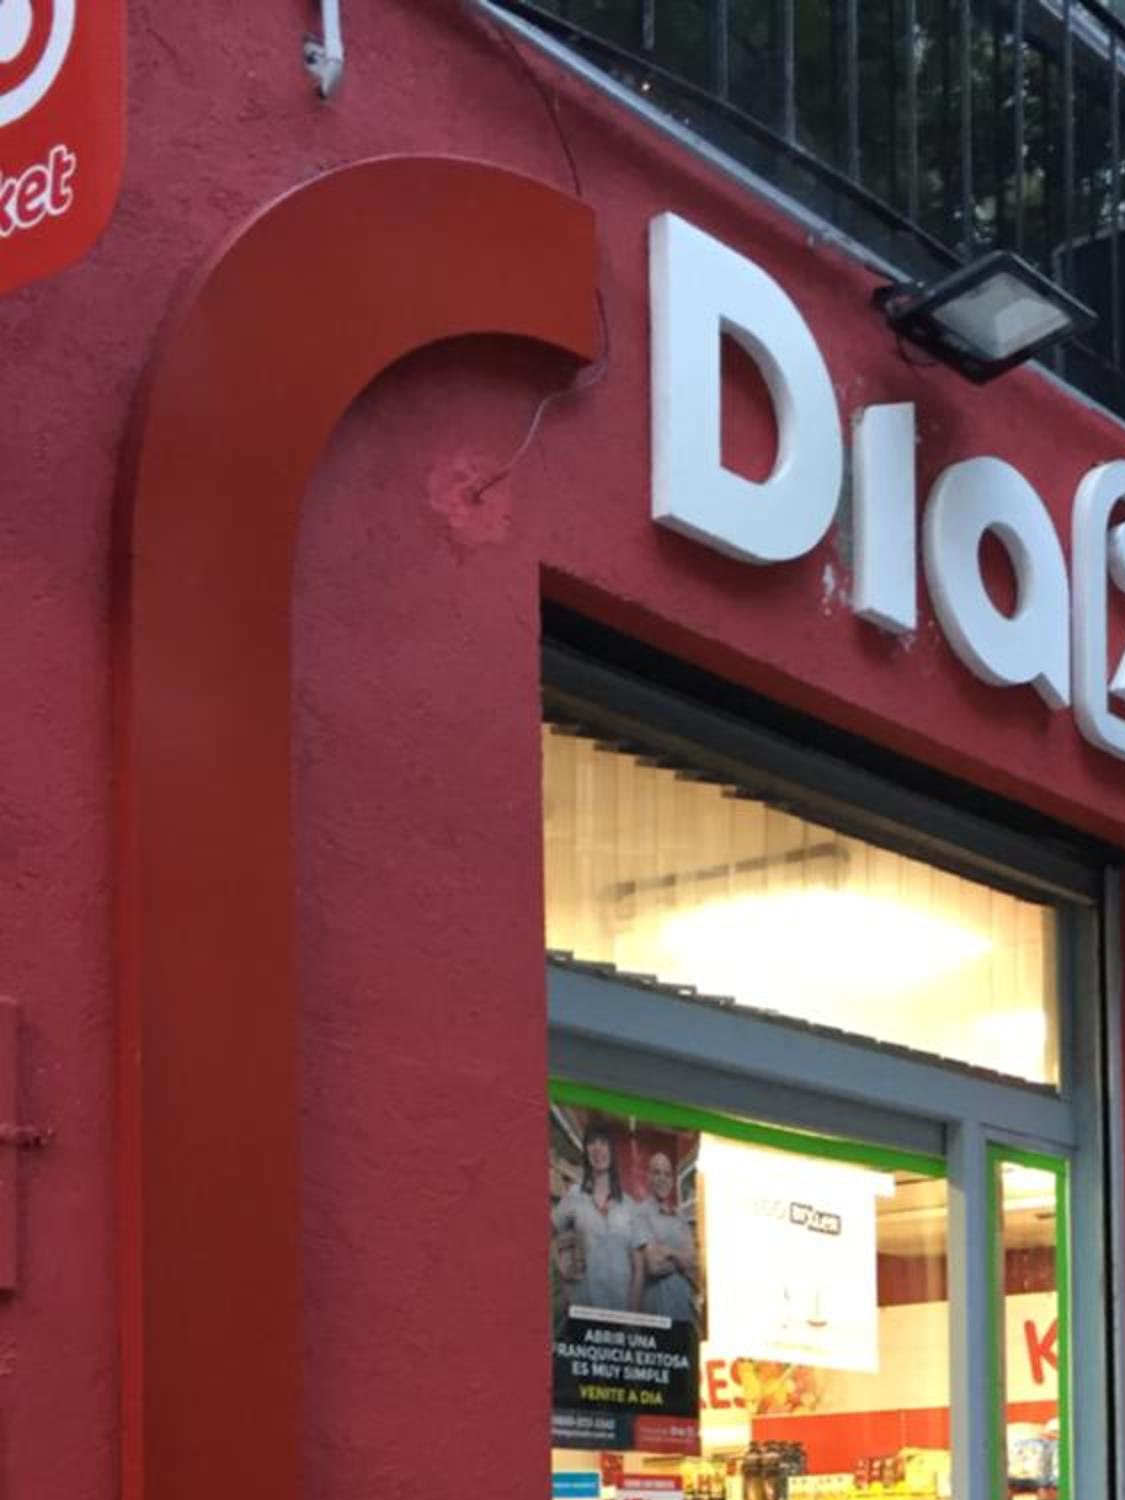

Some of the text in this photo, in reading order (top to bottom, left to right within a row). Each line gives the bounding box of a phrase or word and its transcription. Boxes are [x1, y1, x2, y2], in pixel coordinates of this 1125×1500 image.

[584, 1329, 657, 1349] ABRIR UNA
[556, 1343, 689, 1369] RANQUICIA EXITOSA
[571, 1361, 669, 1384] ES MUY SIMPLE
[579, 1384, 663, 1406] VENITE A DIA
